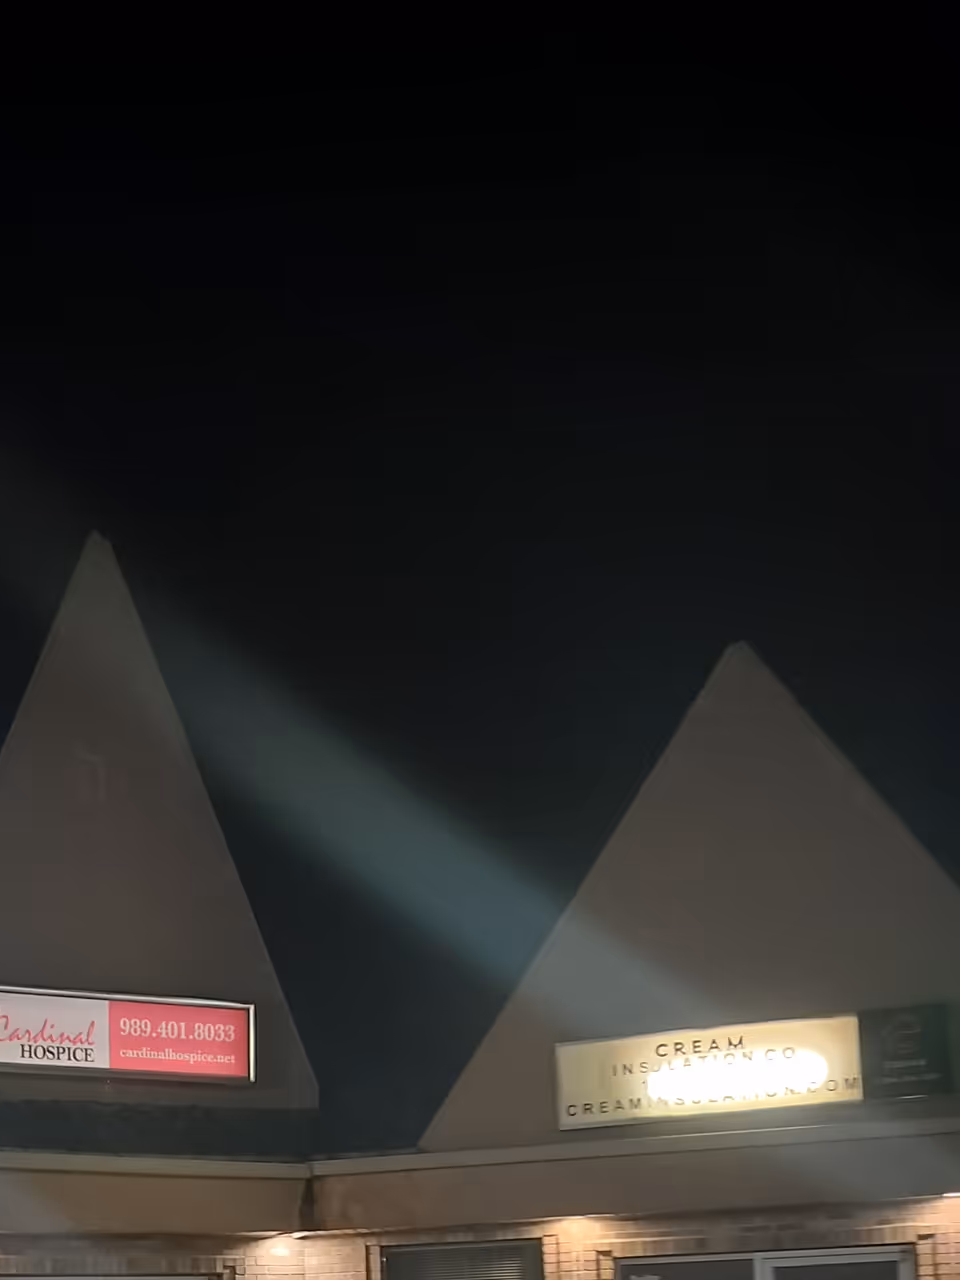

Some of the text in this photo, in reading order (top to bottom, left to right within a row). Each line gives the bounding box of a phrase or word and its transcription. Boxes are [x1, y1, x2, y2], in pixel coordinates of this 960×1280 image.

[120, 1017, 236, 1042] 989.401.8033
[19, 1043, 95, 1063] HOSPICE
[119, 1047, 236, 1065] cardinalhospice.net
[655, 1036, 744, 1057] CREAM
